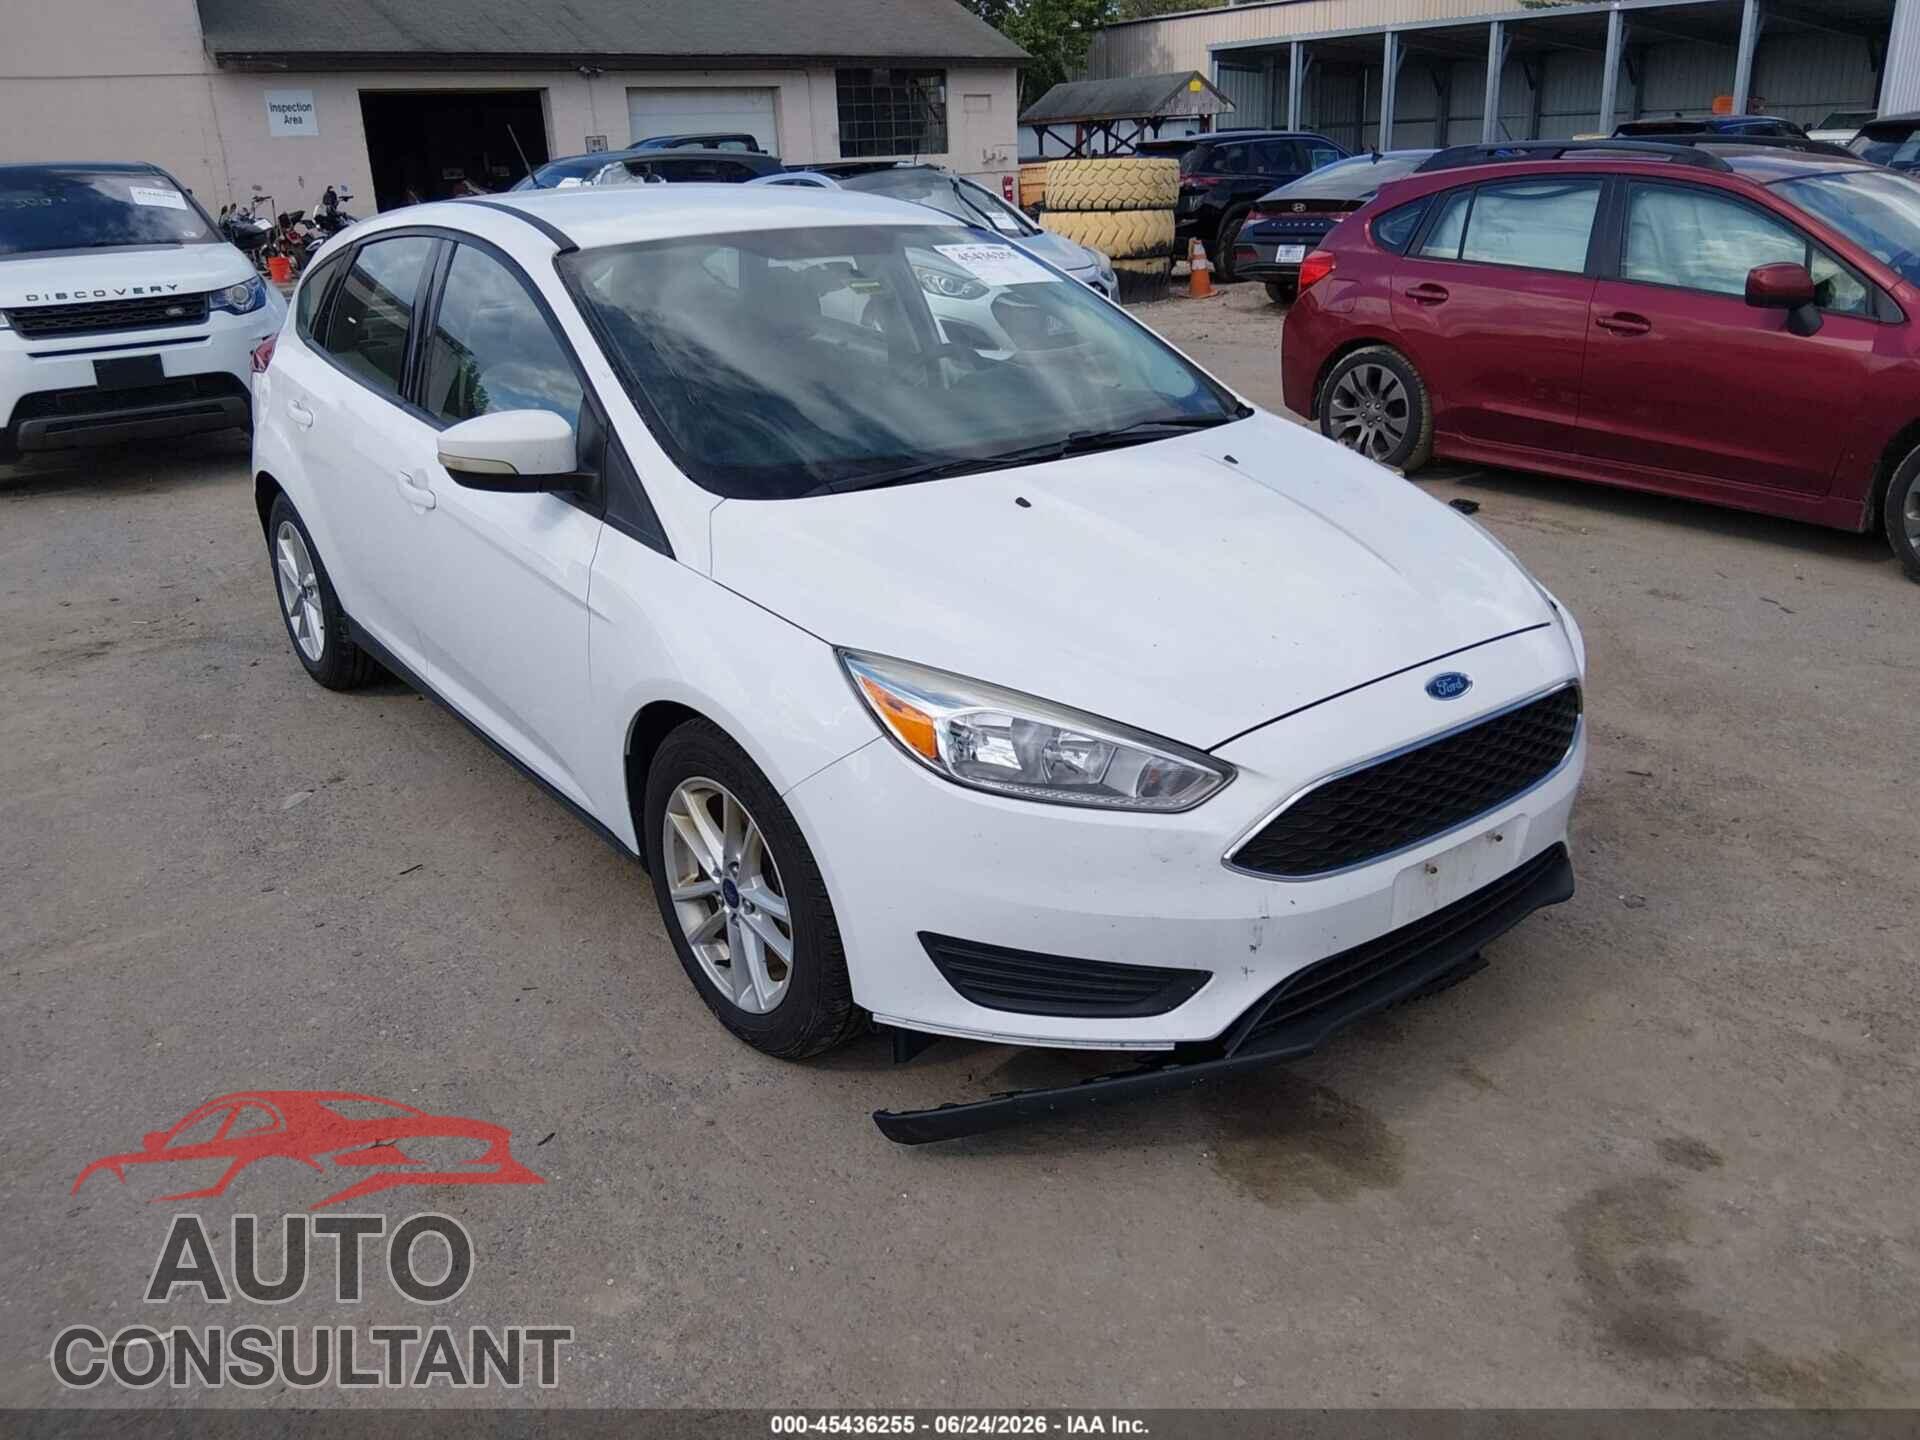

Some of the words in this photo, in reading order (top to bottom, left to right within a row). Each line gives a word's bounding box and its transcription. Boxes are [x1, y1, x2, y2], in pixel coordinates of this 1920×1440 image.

[269, 102, 313, 114] Inspection
[283, 115, 304, 125] Area
[25, 282, 180, 303] DISCOVERY
[1436, 677, 1464, 696] Ford
